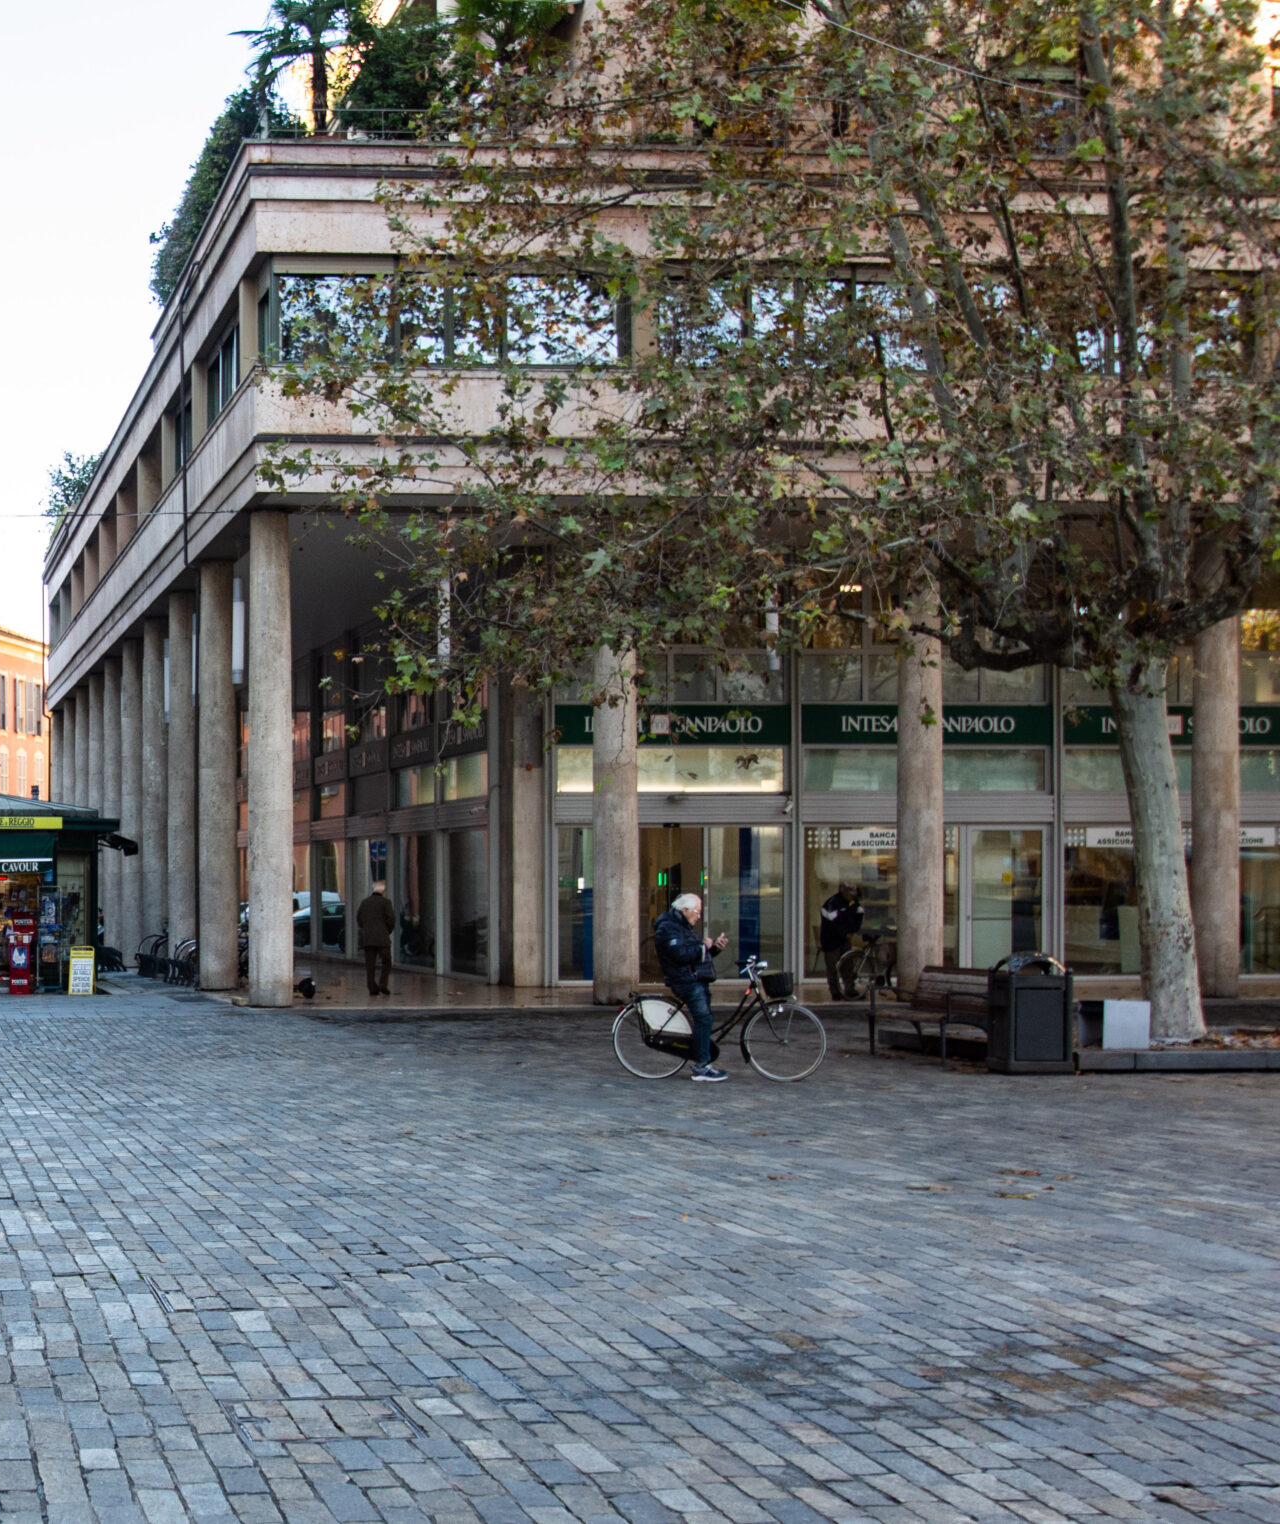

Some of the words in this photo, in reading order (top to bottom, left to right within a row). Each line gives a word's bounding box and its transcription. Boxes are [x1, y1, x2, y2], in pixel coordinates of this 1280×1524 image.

[841, 715, 898, 733] INTESA
[941, 716, 1016, 733] ANPAOLO
[9, 817, 35, 826] REGGIO
[869, 831, 896, 839] BANCA
[1, 861, 39, 873] CAVOUR
